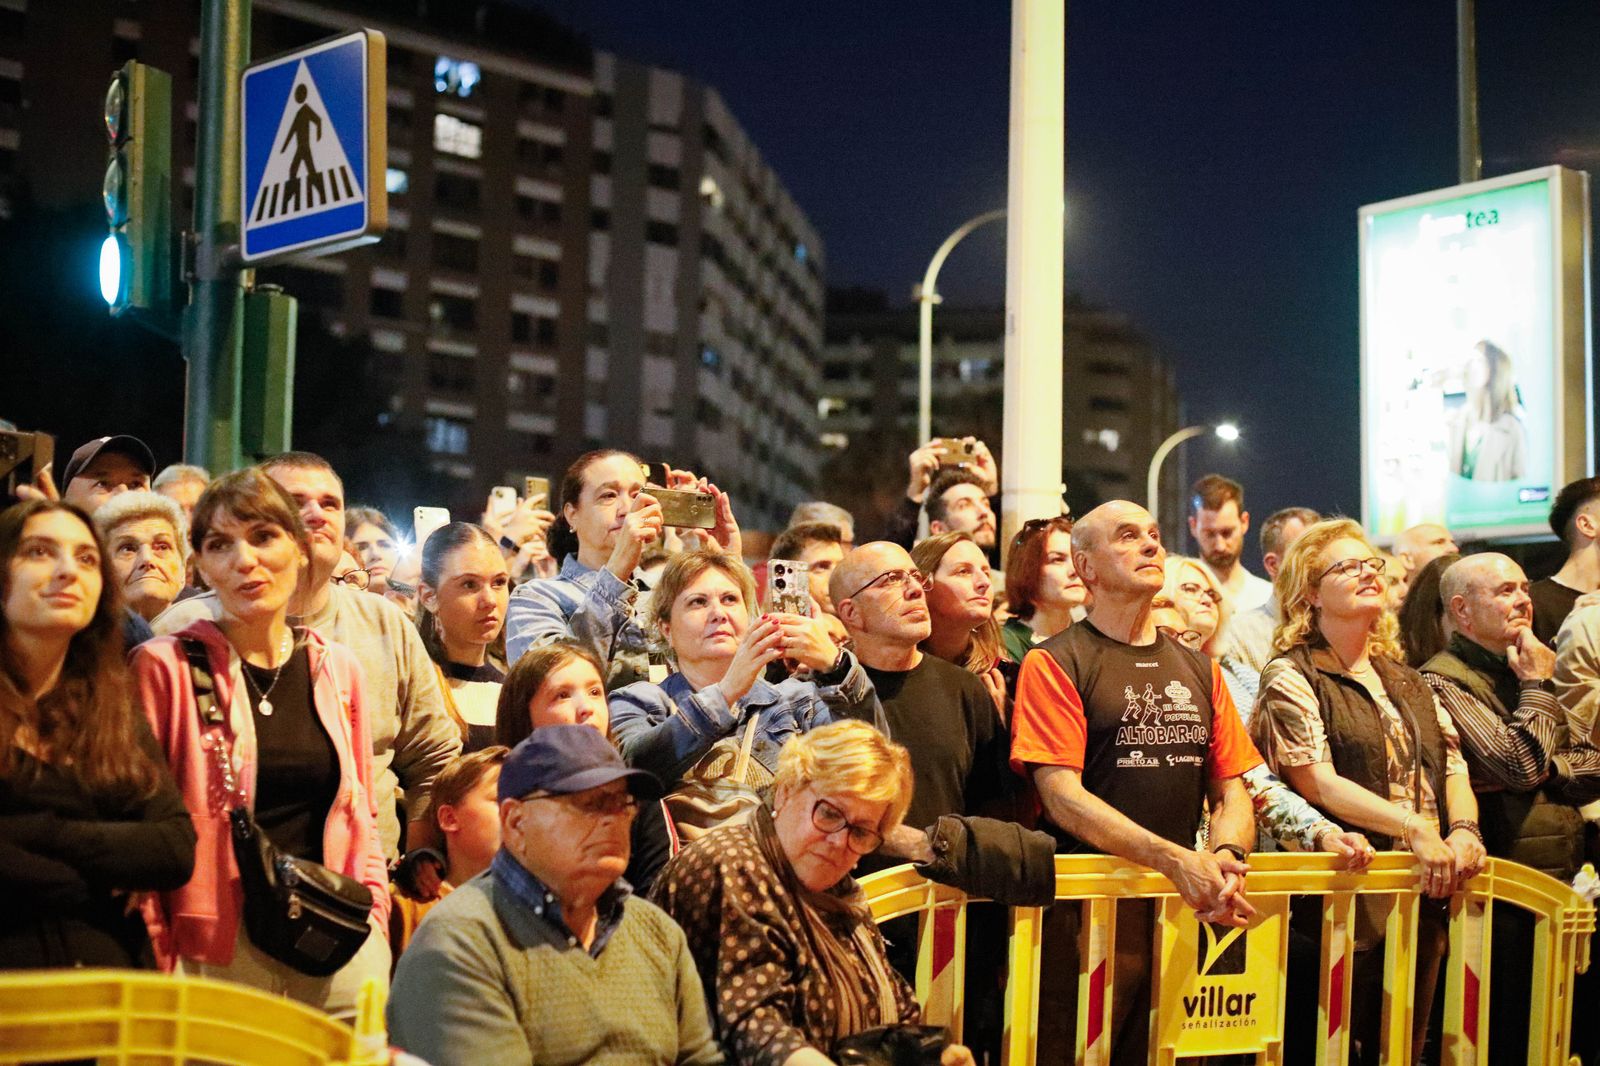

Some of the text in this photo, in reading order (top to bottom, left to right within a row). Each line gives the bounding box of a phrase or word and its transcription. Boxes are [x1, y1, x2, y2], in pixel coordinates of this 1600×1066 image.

[1164, 713, 1201, 722] POPULAR
[1115, 725, 1207, 745] ALTOBAR-09
[1183, 985, 1257, 1018] villar
[1181, 1018, 1257, 1030] señalización
